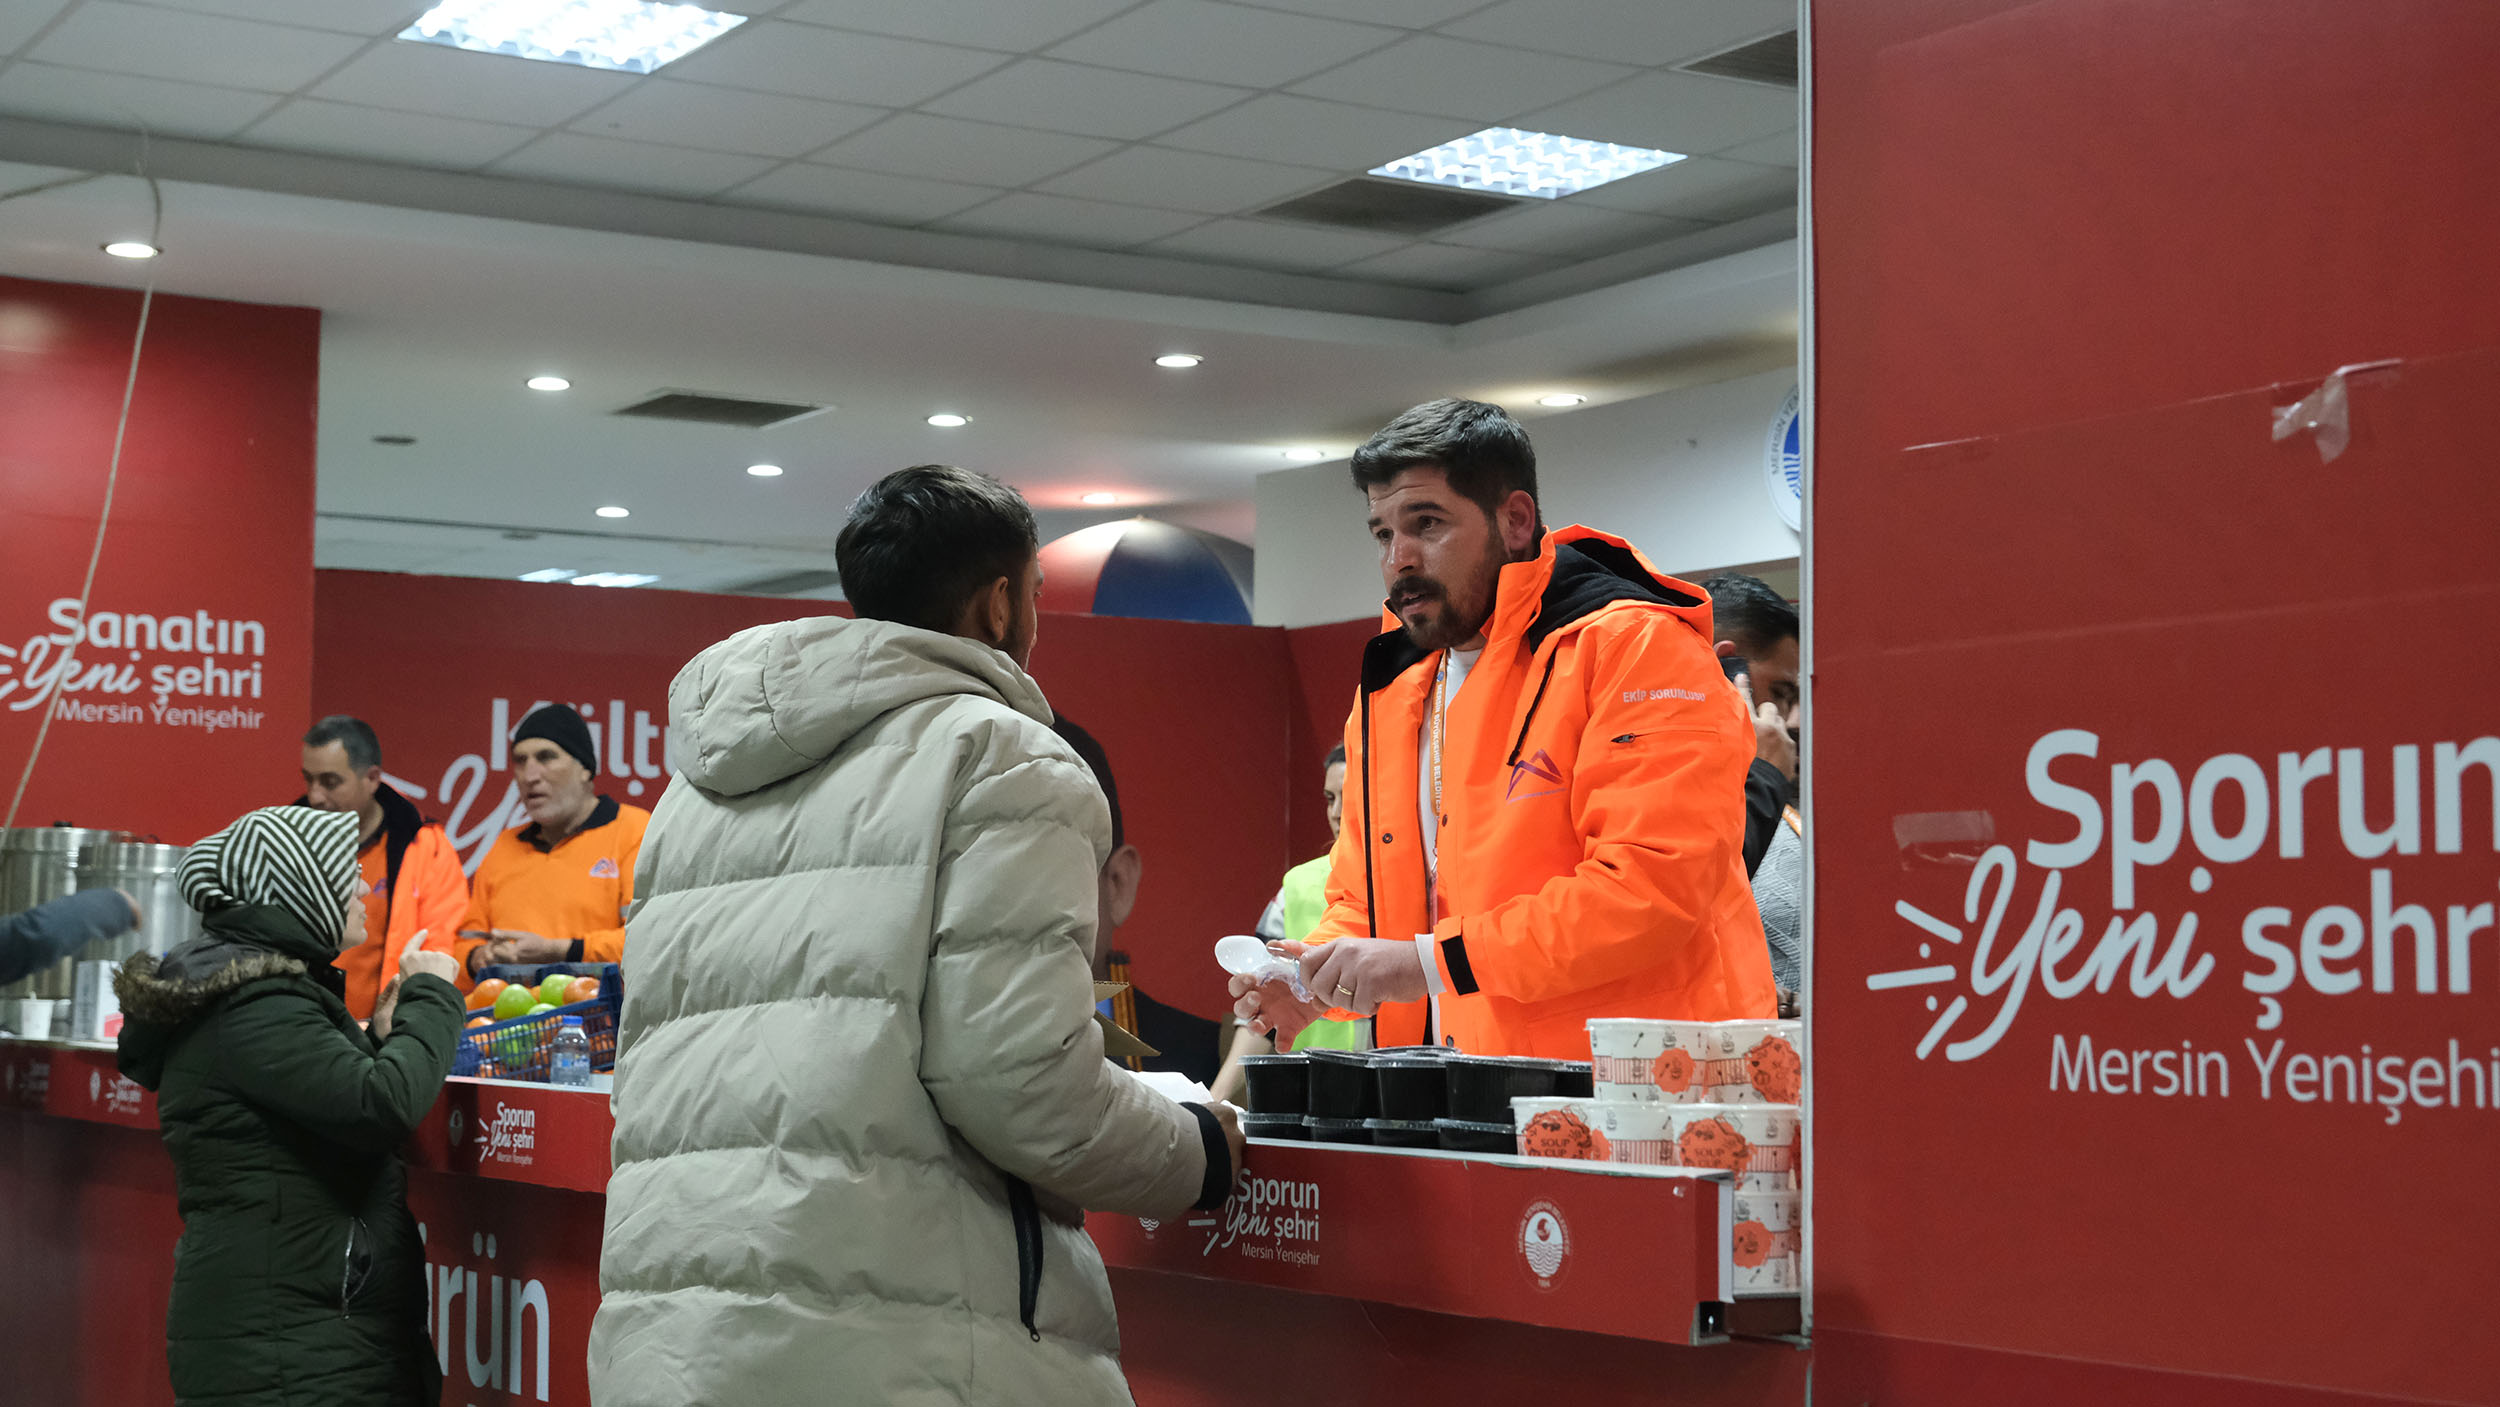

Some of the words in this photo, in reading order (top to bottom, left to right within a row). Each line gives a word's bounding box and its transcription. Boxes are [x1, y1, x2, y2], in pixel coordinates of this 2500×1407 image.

[48, 598, 265, 656] Sanatın
[9, 635, 142, 711] Yeni
[151, 656, 262, 706] şehri
[56, 698, 144, 723] Mersin
[150, 702, 264, 733] Yenişehir
[2025, 728, 2500, 910] Sporun
[1944, 844, 2216, 1062] Yeni
[2241, 868, 2500, 1031] şehr
[2049, 1034, 2230, 1098] Mersin
[497, 1101, 535, 1133] Sporun
[512, 1128, 535, 1153] şehri
[1540, 1138, 1570, 1148] SOUP
[1545, 1148, 1567, 1157] CUP
[1237, 1167, 1320, 1214] Sporun
[1221, 1194, 1271, 1249] Yeni
[1274, 1210, 1319, 1246] şehri
[1241, 1242, 1274, 1260] Mersin
[1276, 1246, 1320, 1268] Yenişehir
